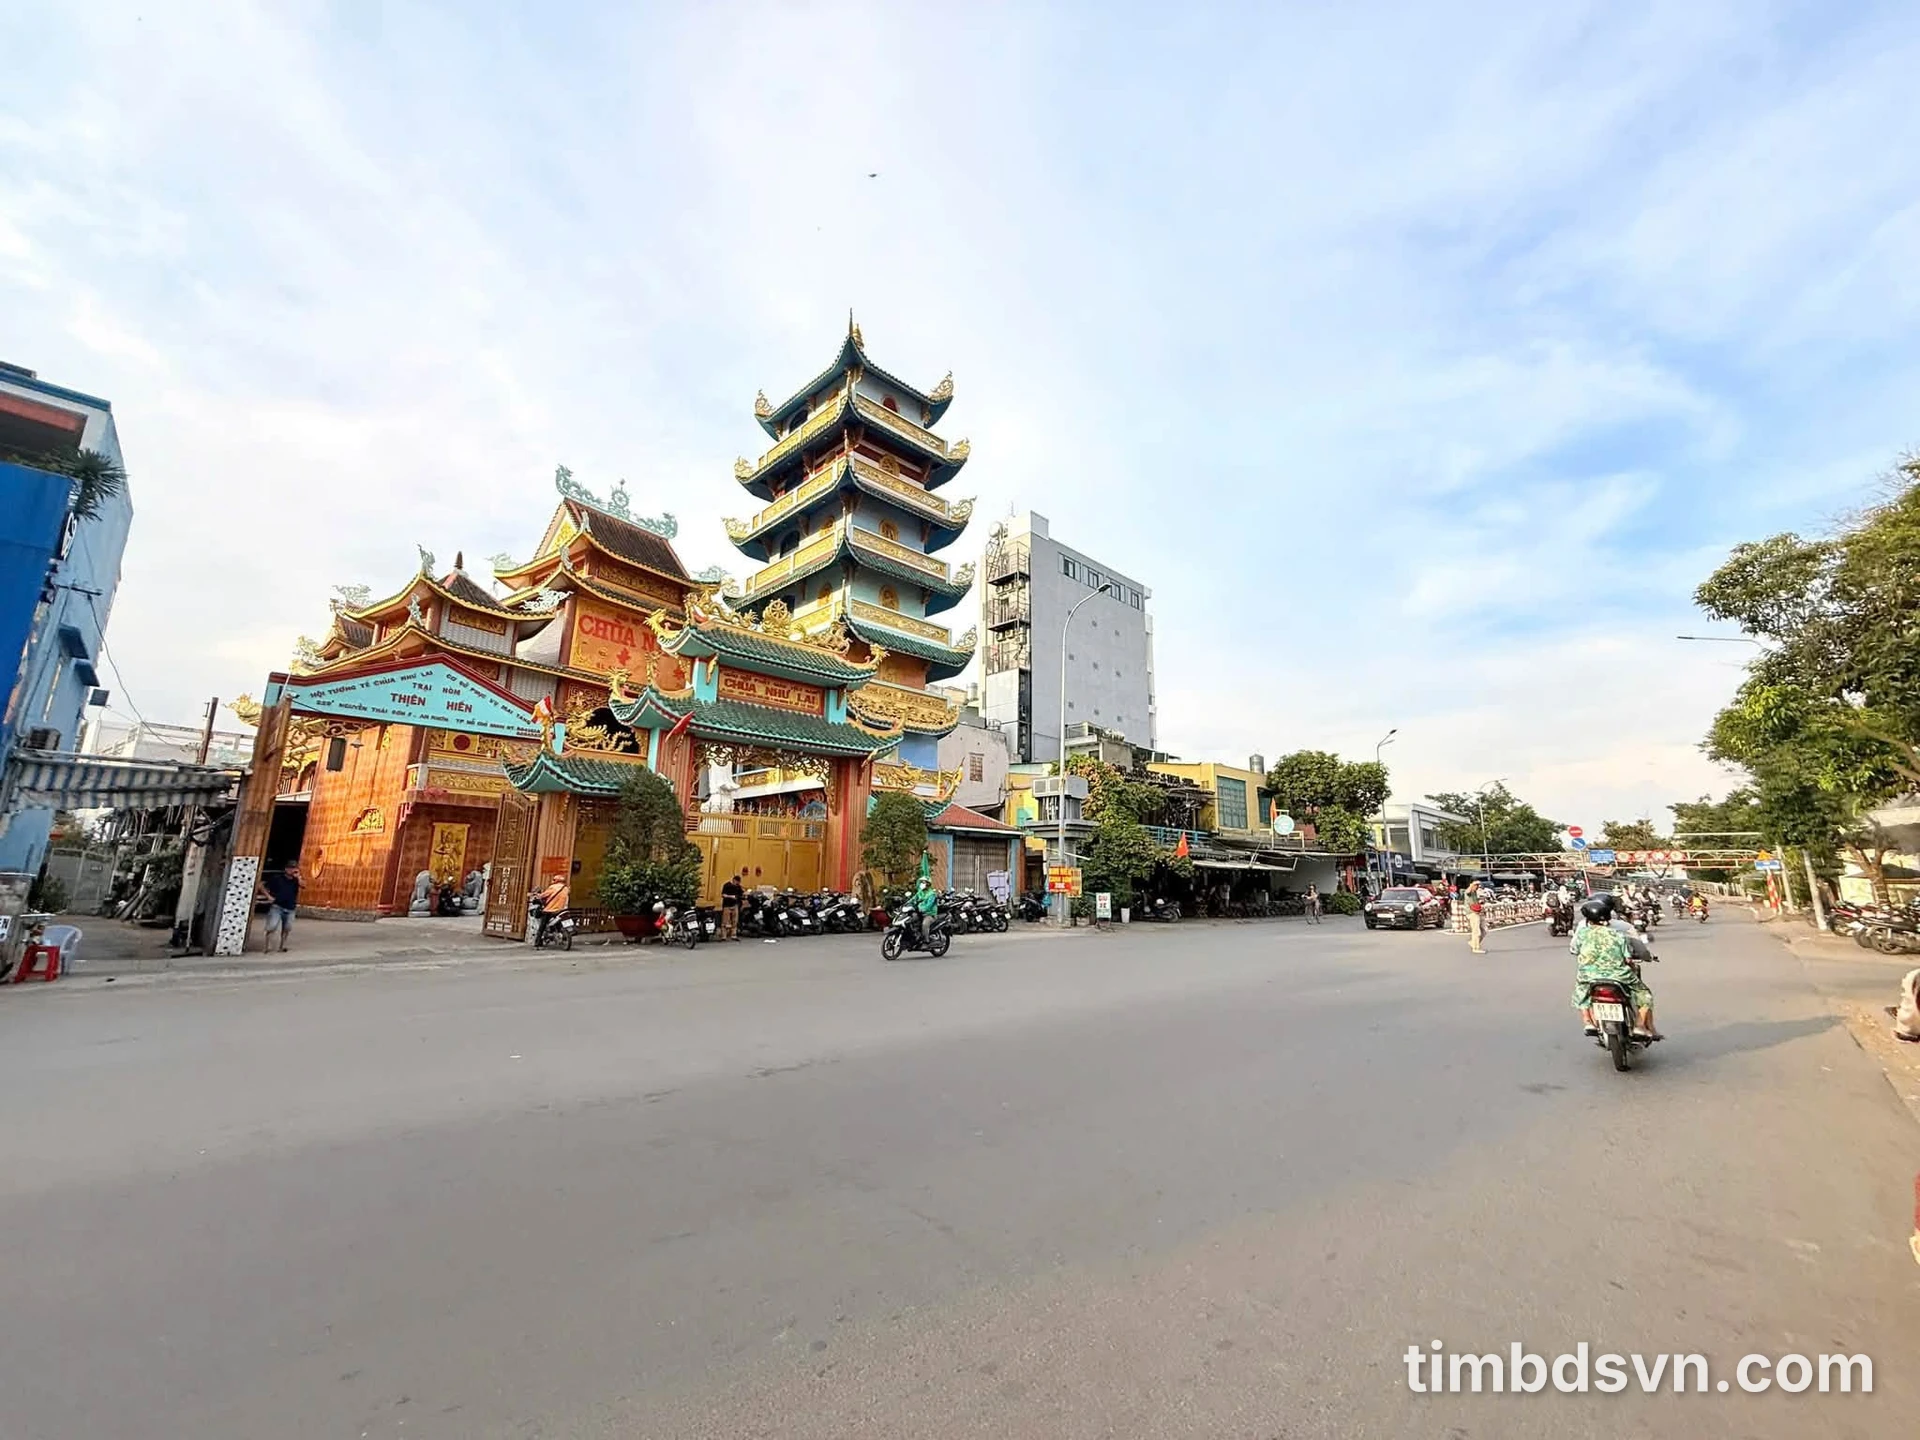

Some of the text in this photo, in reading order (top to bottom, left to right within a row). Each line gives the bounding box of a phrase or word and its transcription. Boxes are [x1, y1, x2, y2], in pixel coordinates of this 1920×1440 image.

[373, 675, 396, 686] CHÙA
[412, 682, 432, 691] TRẠI
[390, 692, 426, 707] THIỆN
[765, 686, 792, 699] NHƯ
[797, 693, 815, 705] LAI
[500, 704, 514, 715] MAI
